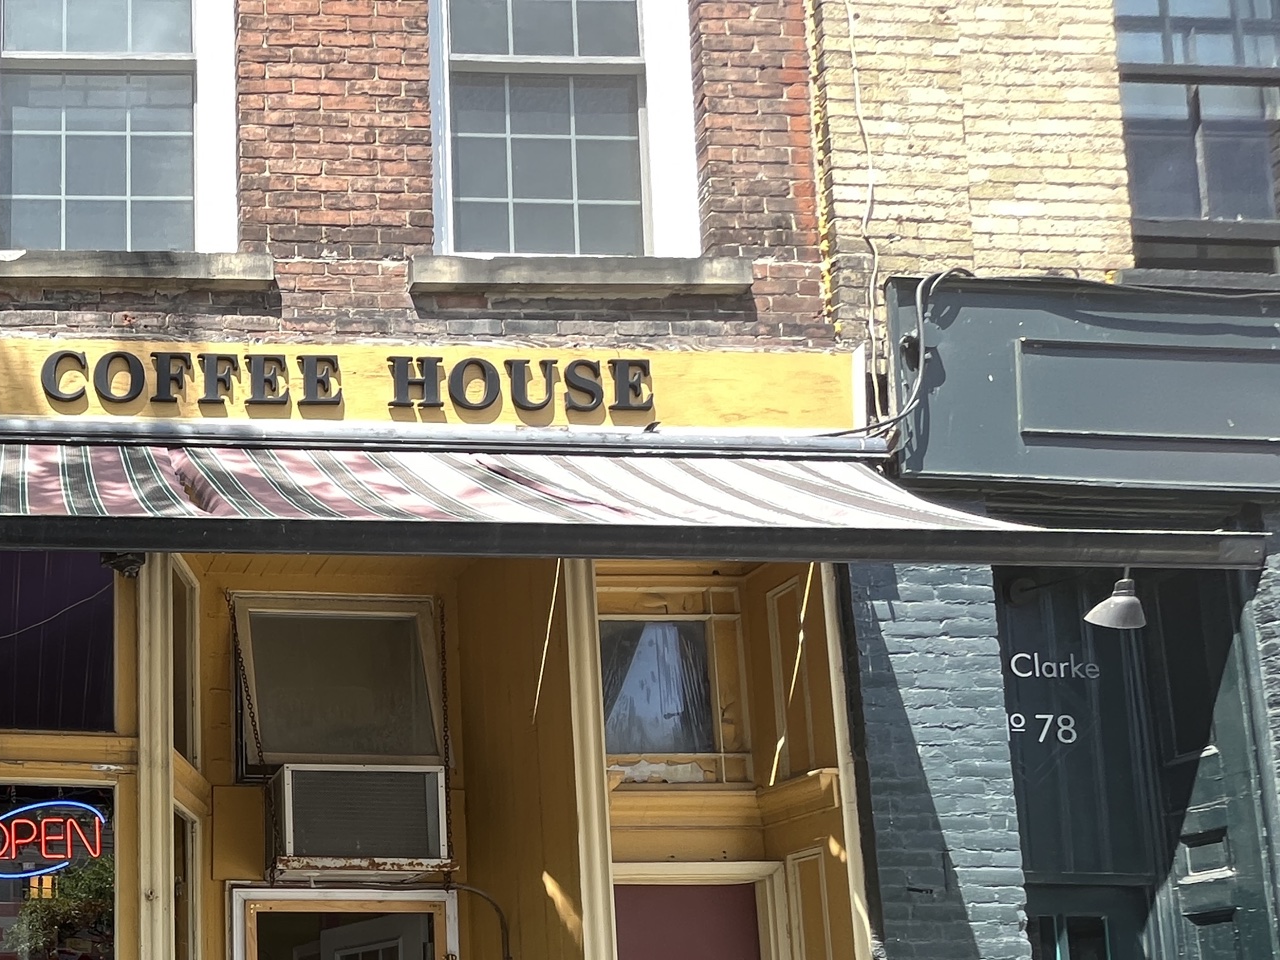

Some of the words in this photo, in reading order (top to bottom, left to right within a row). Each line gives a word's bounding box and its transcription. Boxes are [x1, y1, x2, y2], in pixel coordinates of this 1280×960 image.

[41, 351, 343, 406] COFFEE
[386, 355, 655, 412] HOUSE
[1010, 652, 1100, 679] Clarke
[1034, 714, 1078, 744] 78
